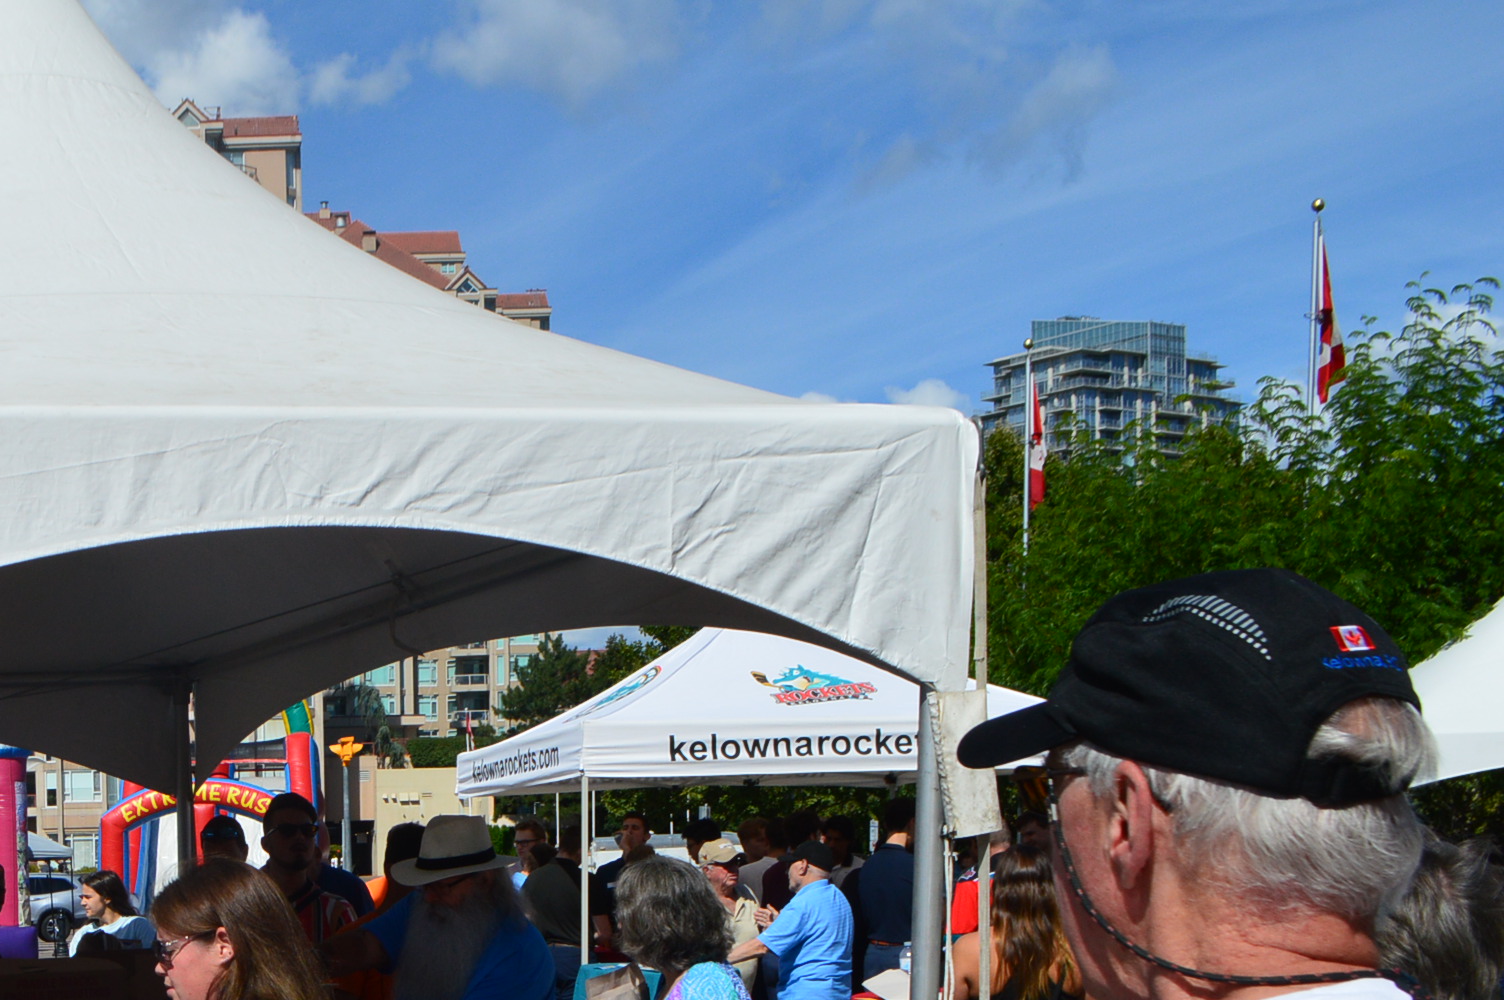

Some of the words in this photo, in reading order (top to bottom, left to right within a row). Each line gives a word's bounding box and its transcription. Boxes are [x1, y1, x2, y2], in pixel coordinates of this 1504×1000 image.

[770, 681, 877, 704] ROCKETS
[669, 728, 918, 762] kelownarocke
[472, 746, 560, 783] kelownarockets.com
[121, 783, 222, 823] EXTRME
[226, 785, 272, 814] RUS
